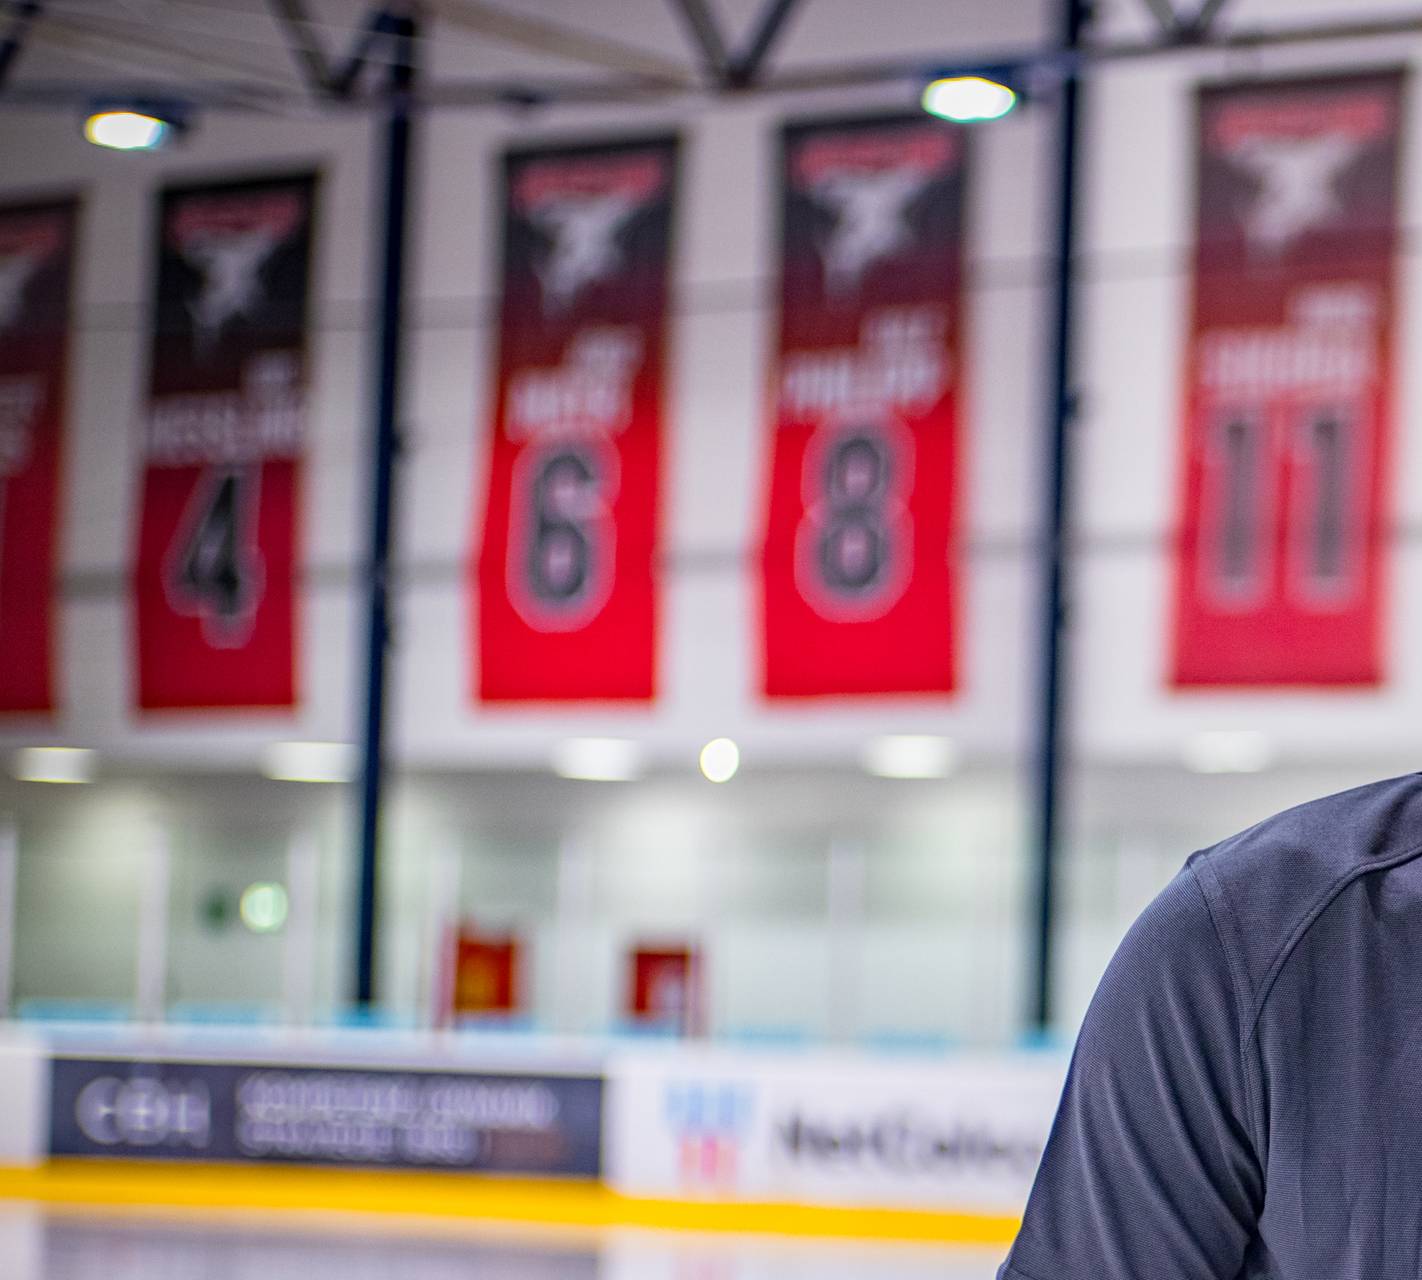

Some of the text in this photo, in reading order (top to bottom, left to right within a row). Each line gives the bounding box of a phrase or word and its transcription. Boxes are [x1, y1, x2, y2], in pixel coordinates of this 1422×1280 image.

[166, 462, 260, 642] 4
[515, 442, 612, 622] 6
[805, 422, 903, 612] 8
[1210, 408, 1355, 602] 11
